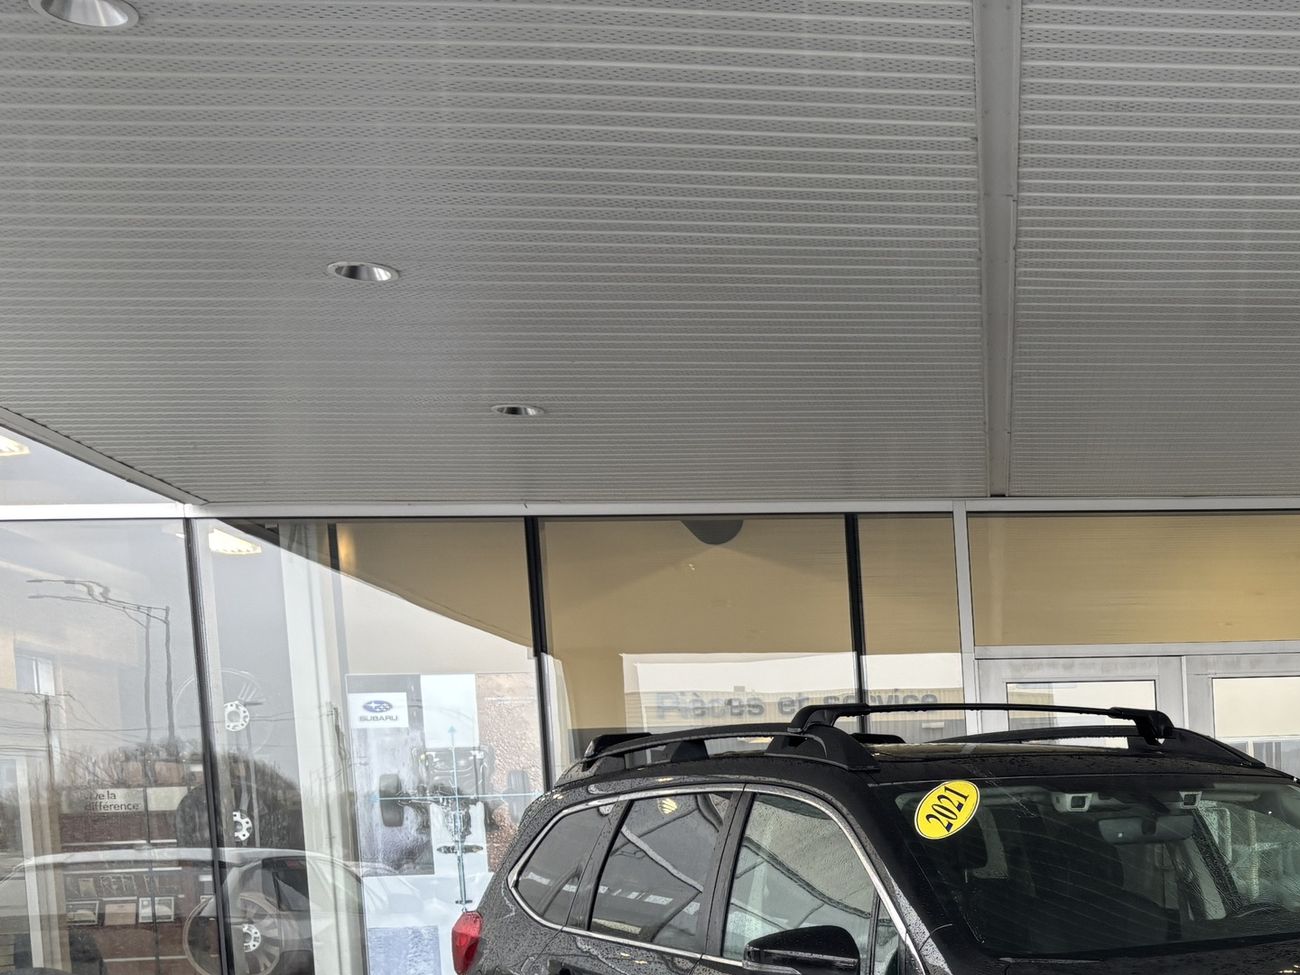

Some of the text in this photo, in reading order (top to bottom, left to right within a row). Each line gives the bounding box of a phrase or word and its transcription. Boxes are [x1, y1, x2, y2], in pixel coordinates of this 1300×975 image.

[107, 790, 117, 800] la
[84, 801, 140, 811] différence
[925, 785, 970, 833] 2021
